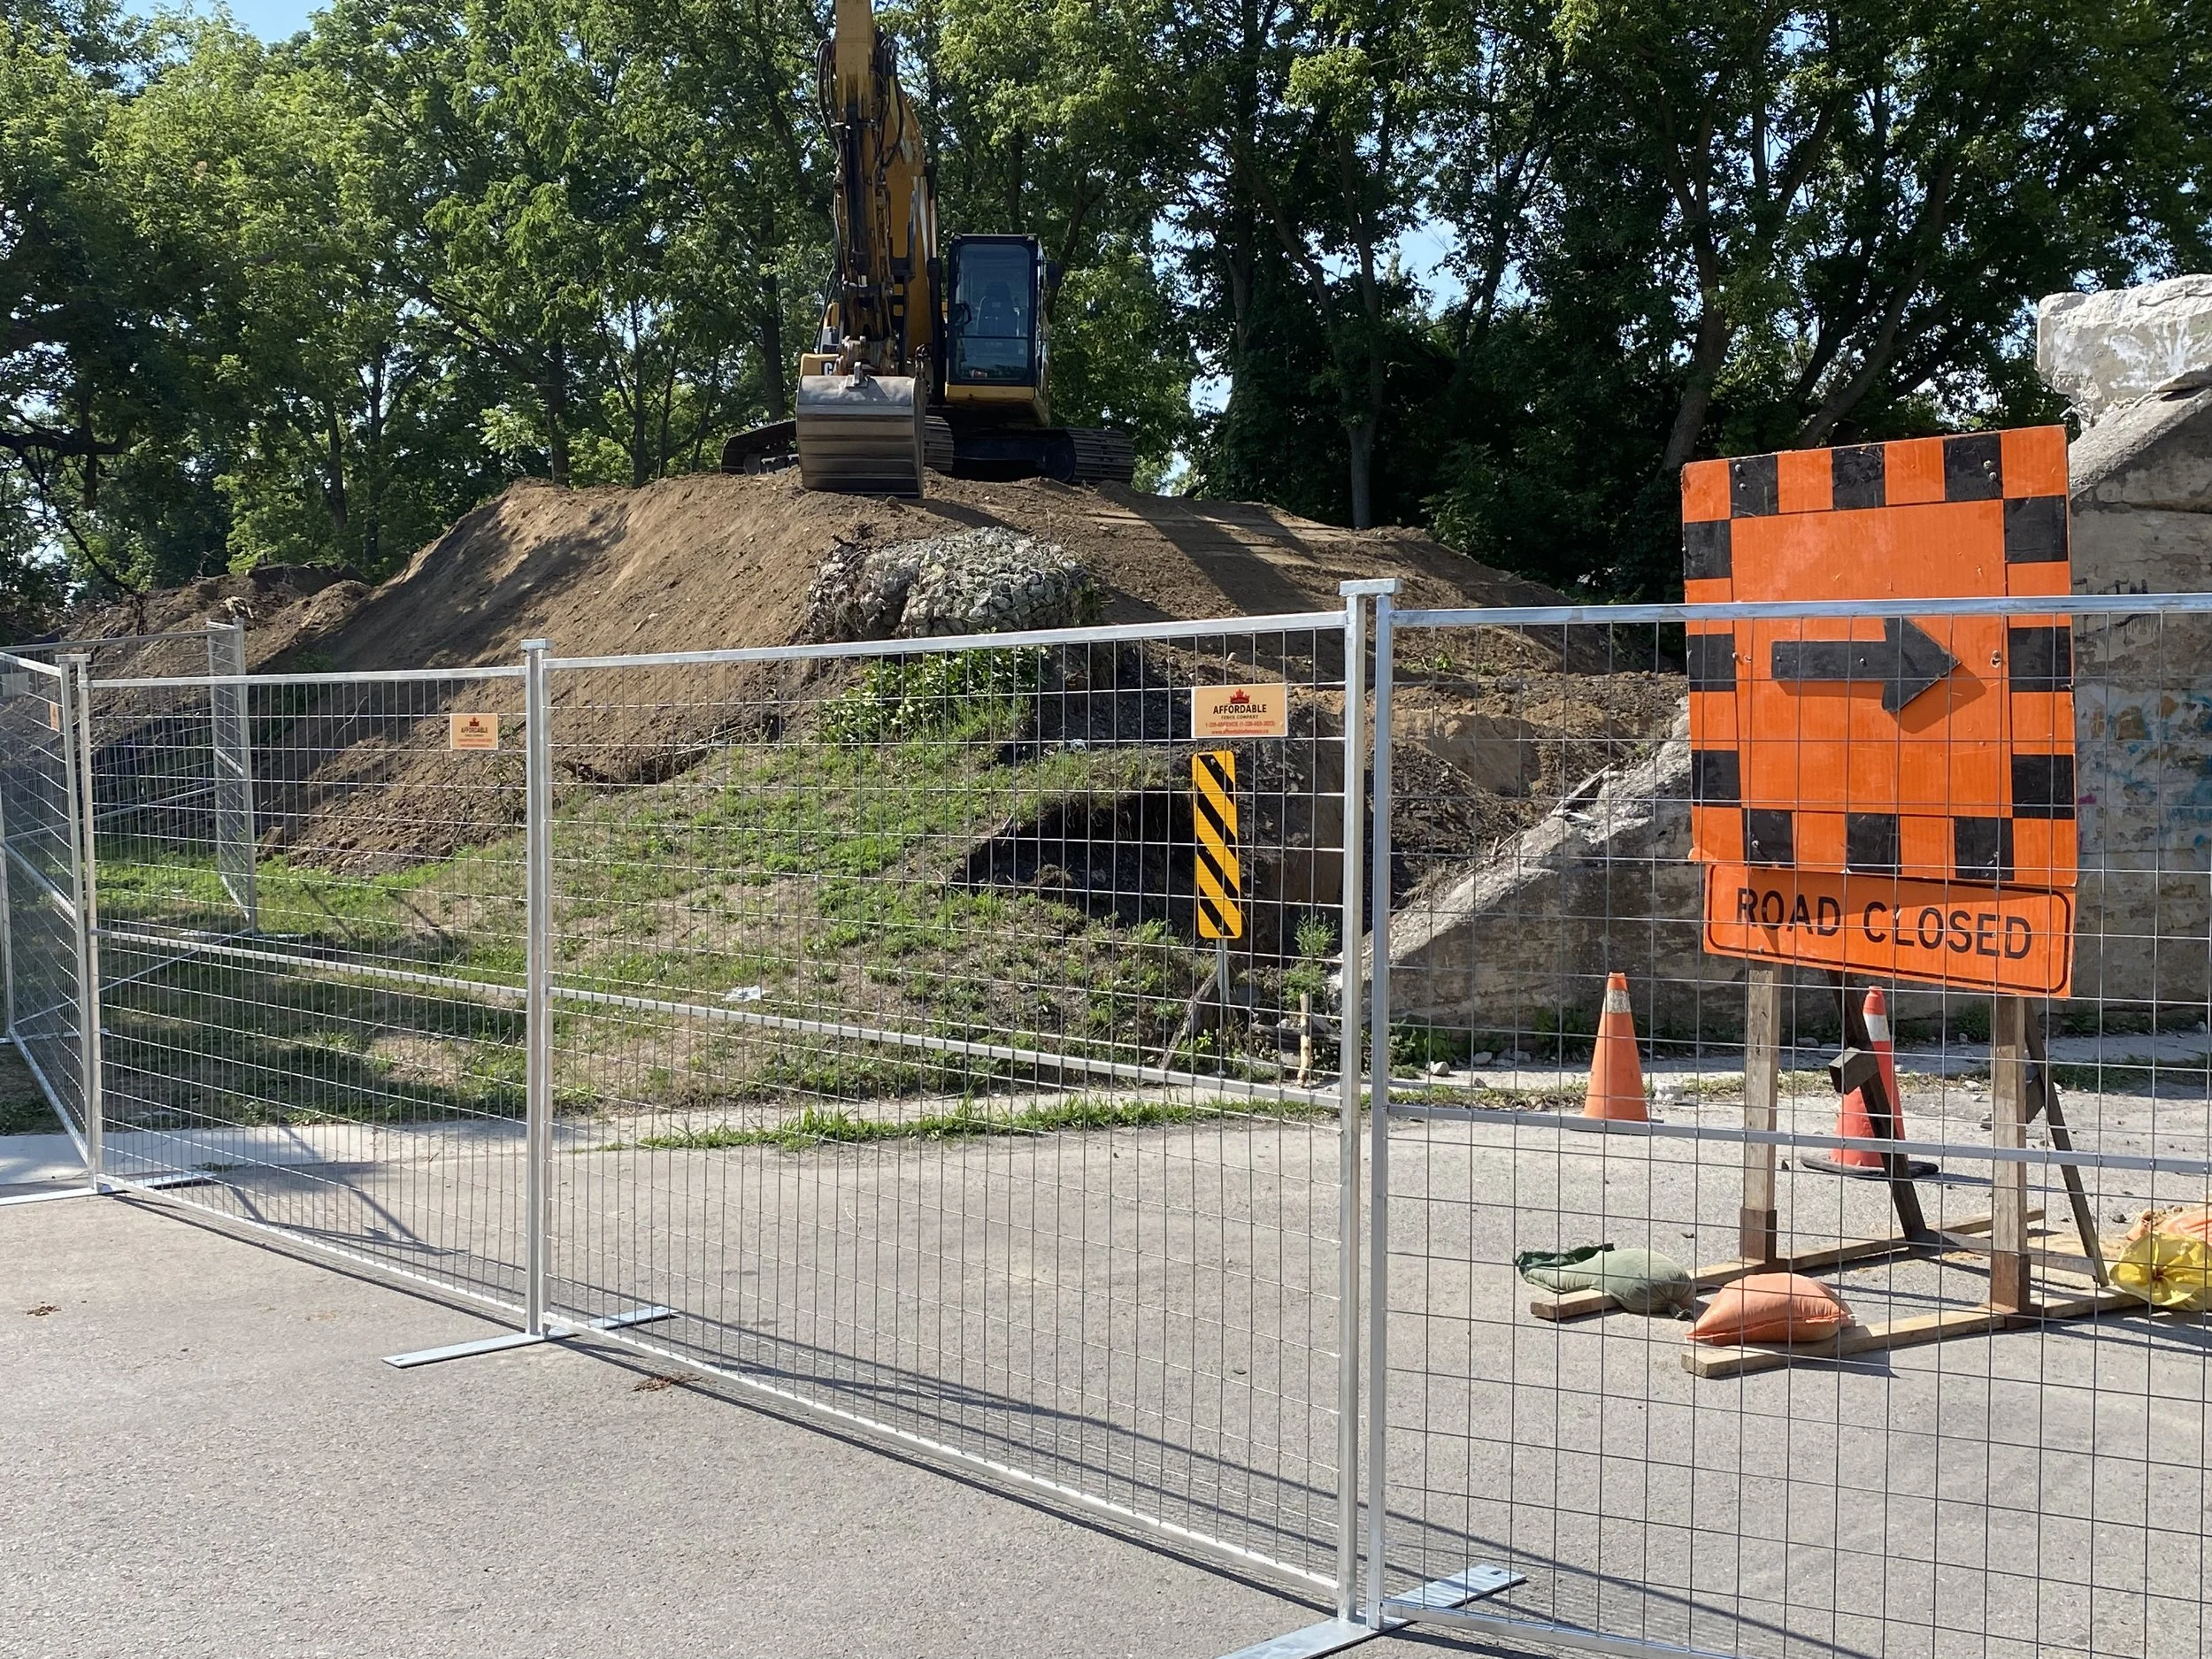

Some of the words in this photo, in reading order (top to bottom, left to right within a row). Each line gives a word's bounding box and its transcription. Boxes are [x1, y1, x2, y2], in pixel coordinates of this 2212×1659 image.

[1213, 704, 1267, 715] AFFORDABLE
[1736, 887, 1841, 937] ROAD
[1863, 900, 2032, 960] CLOSED
